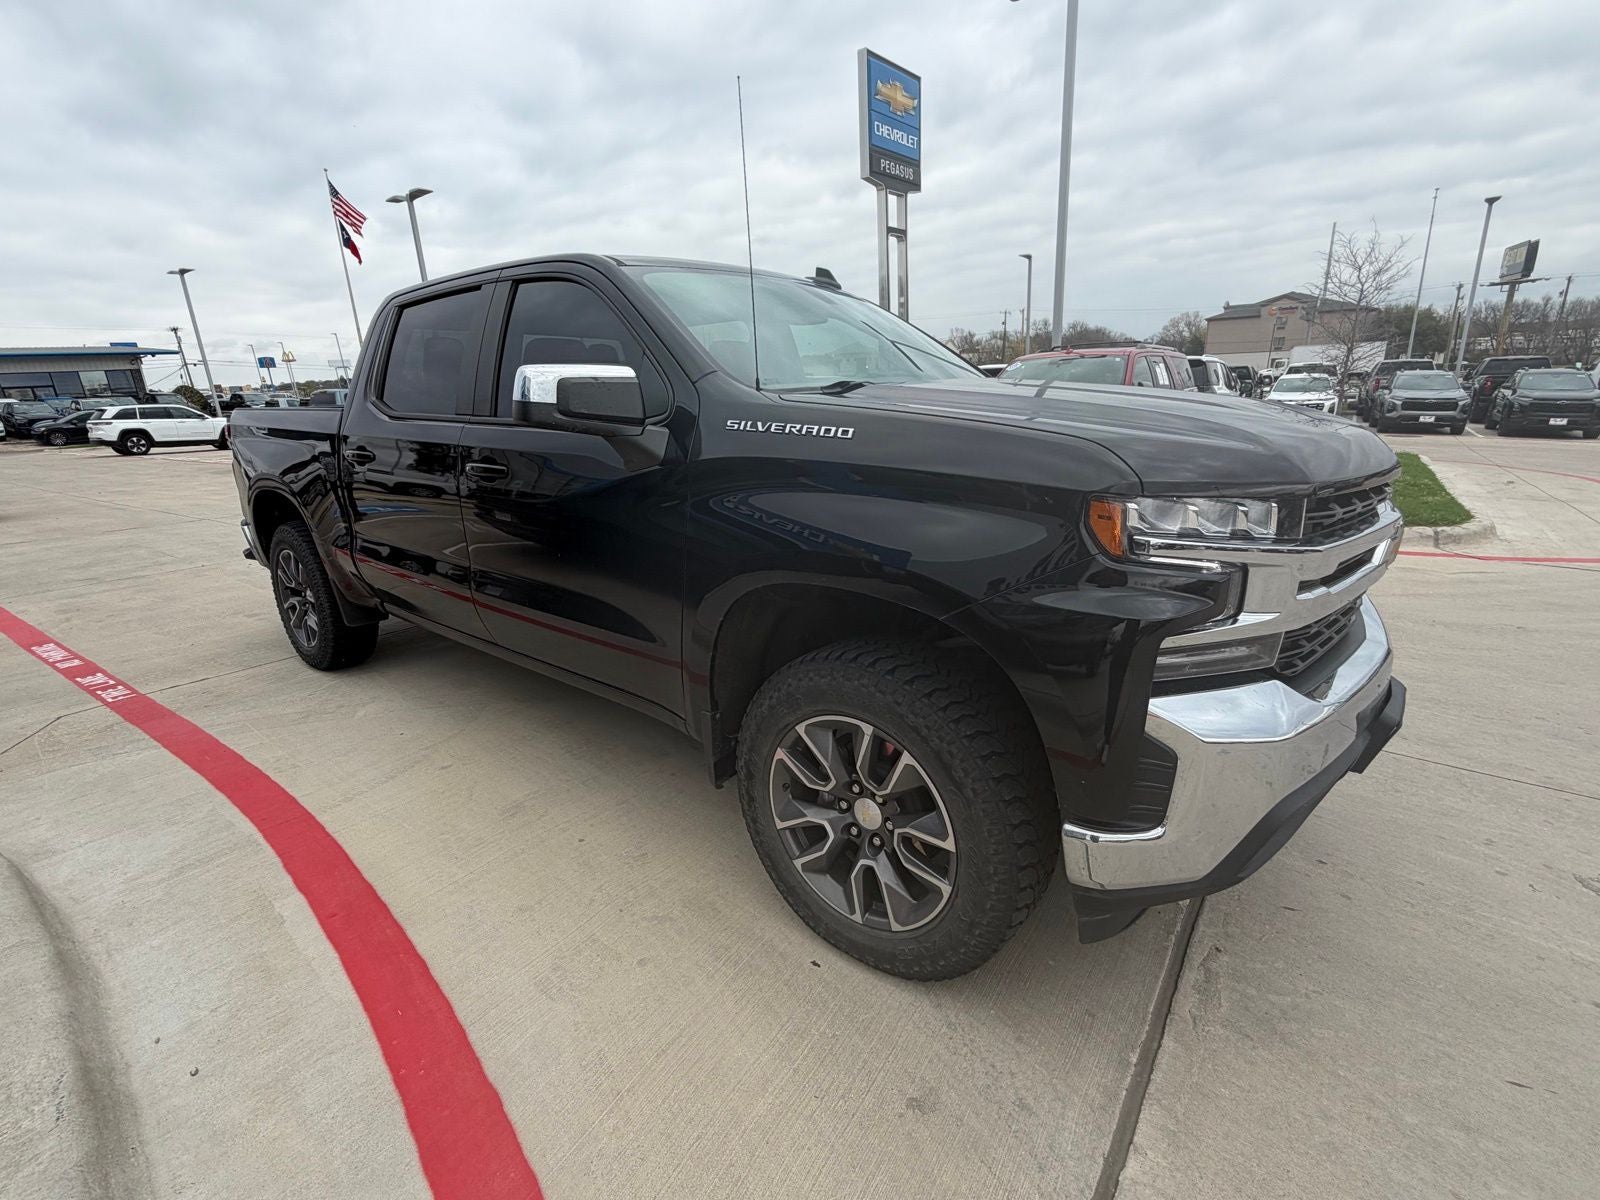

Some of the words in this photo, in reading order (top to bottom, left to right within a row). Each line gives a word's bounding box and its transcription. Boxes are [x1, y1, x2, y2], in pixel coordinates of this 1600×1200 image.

[874, 121, 918, 149] CHEVROLET
[880, 159, 914, 180] PEGASUS
[726, 420, 855, 438] SILVERADO
